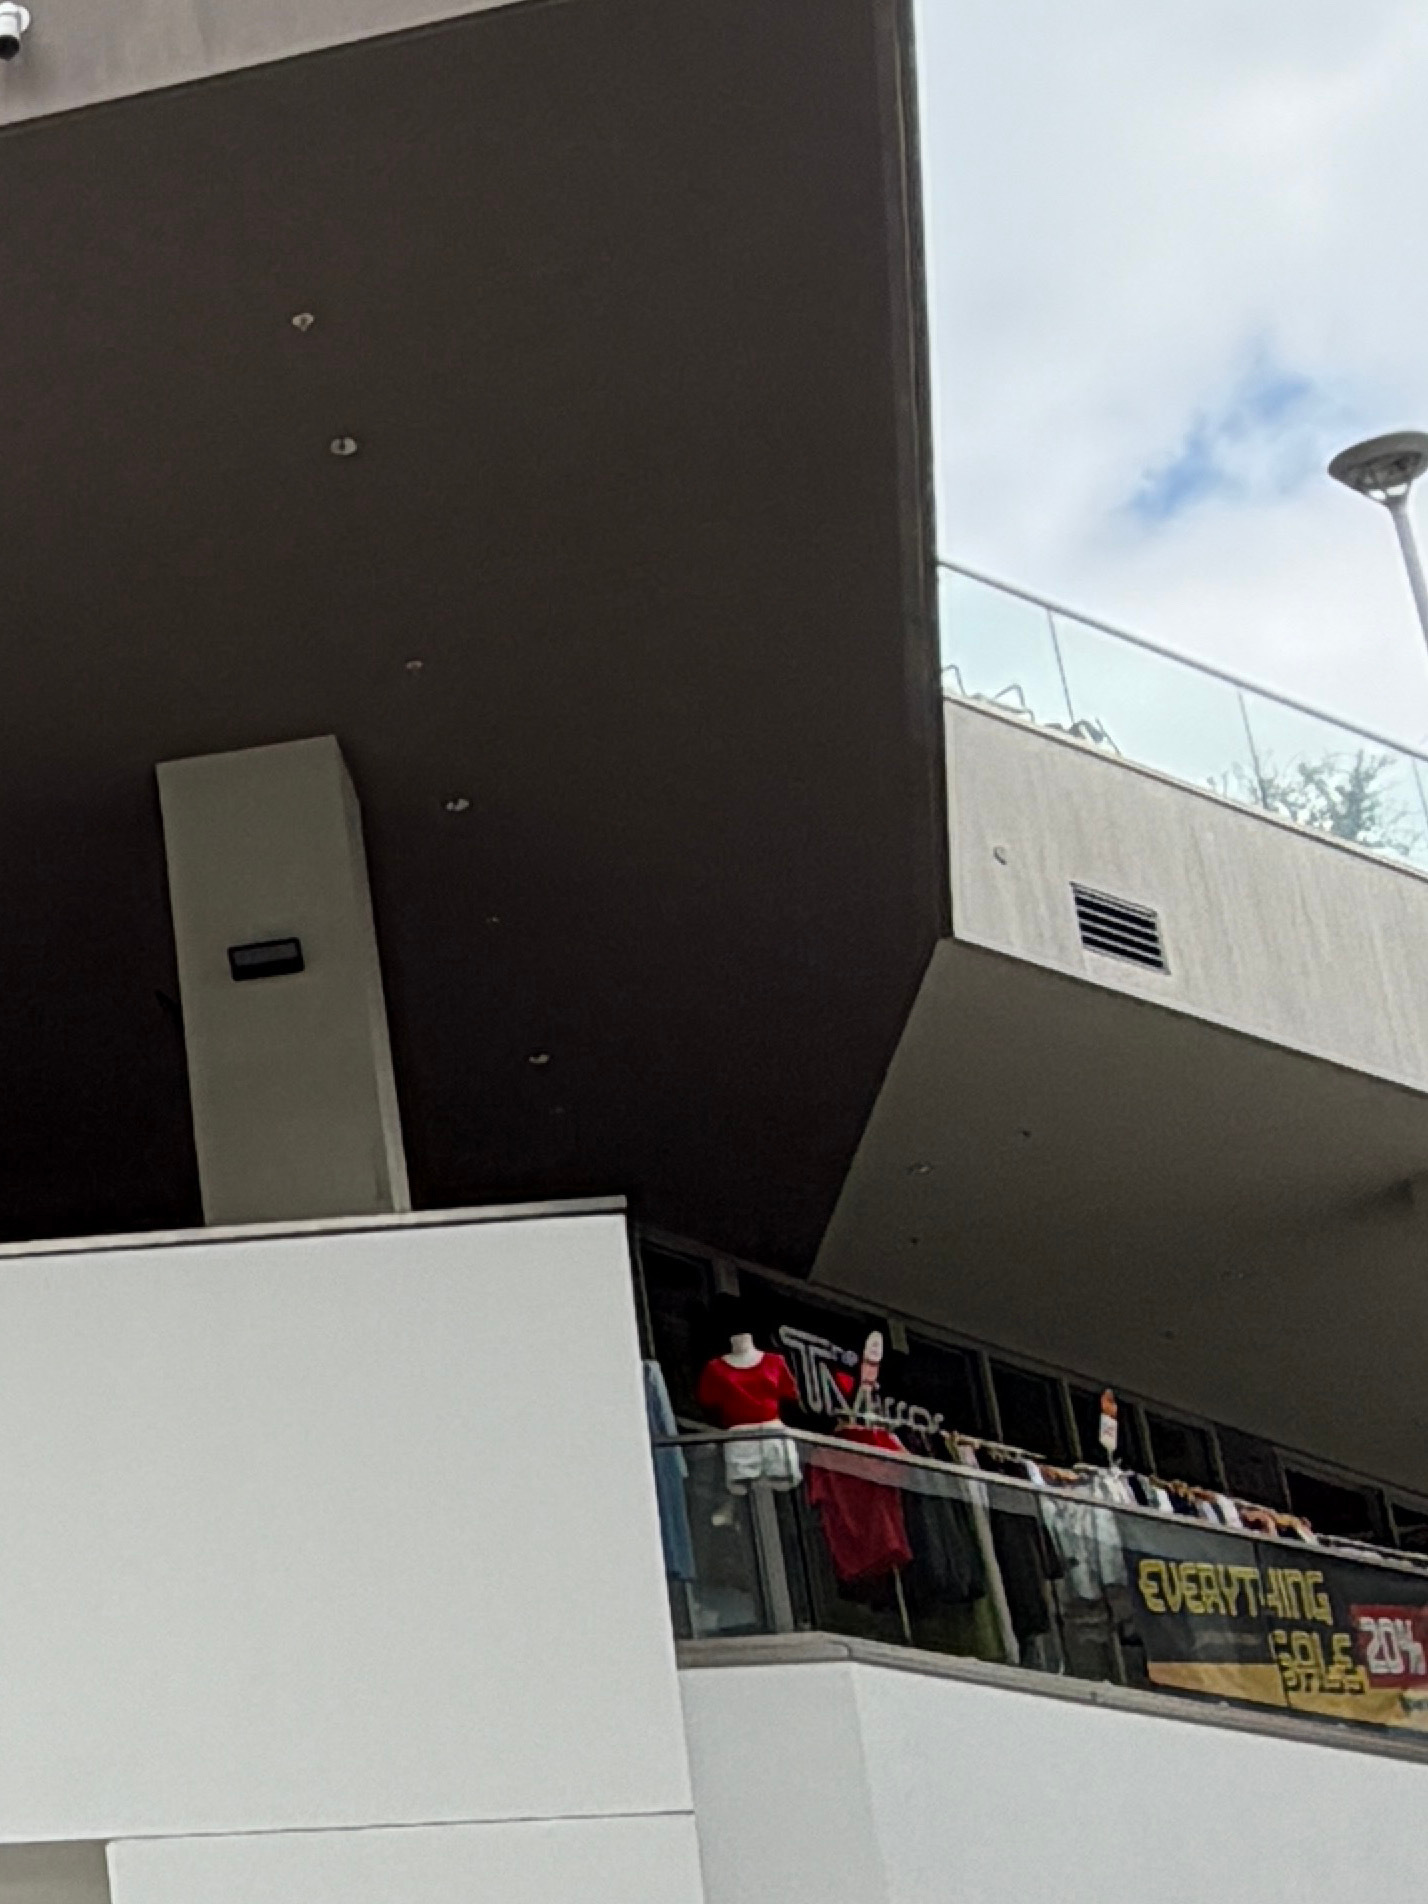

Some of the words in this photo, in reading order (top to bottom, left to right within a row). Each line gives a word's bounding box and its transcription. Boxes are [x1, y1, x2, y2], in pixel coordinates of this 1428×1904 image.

[1138, 1559, 1333, 1626] EVERYTHING
[1268, 1630, 1369, 1694] SALE
[1358, 1616, 1426, 1676] 20%
